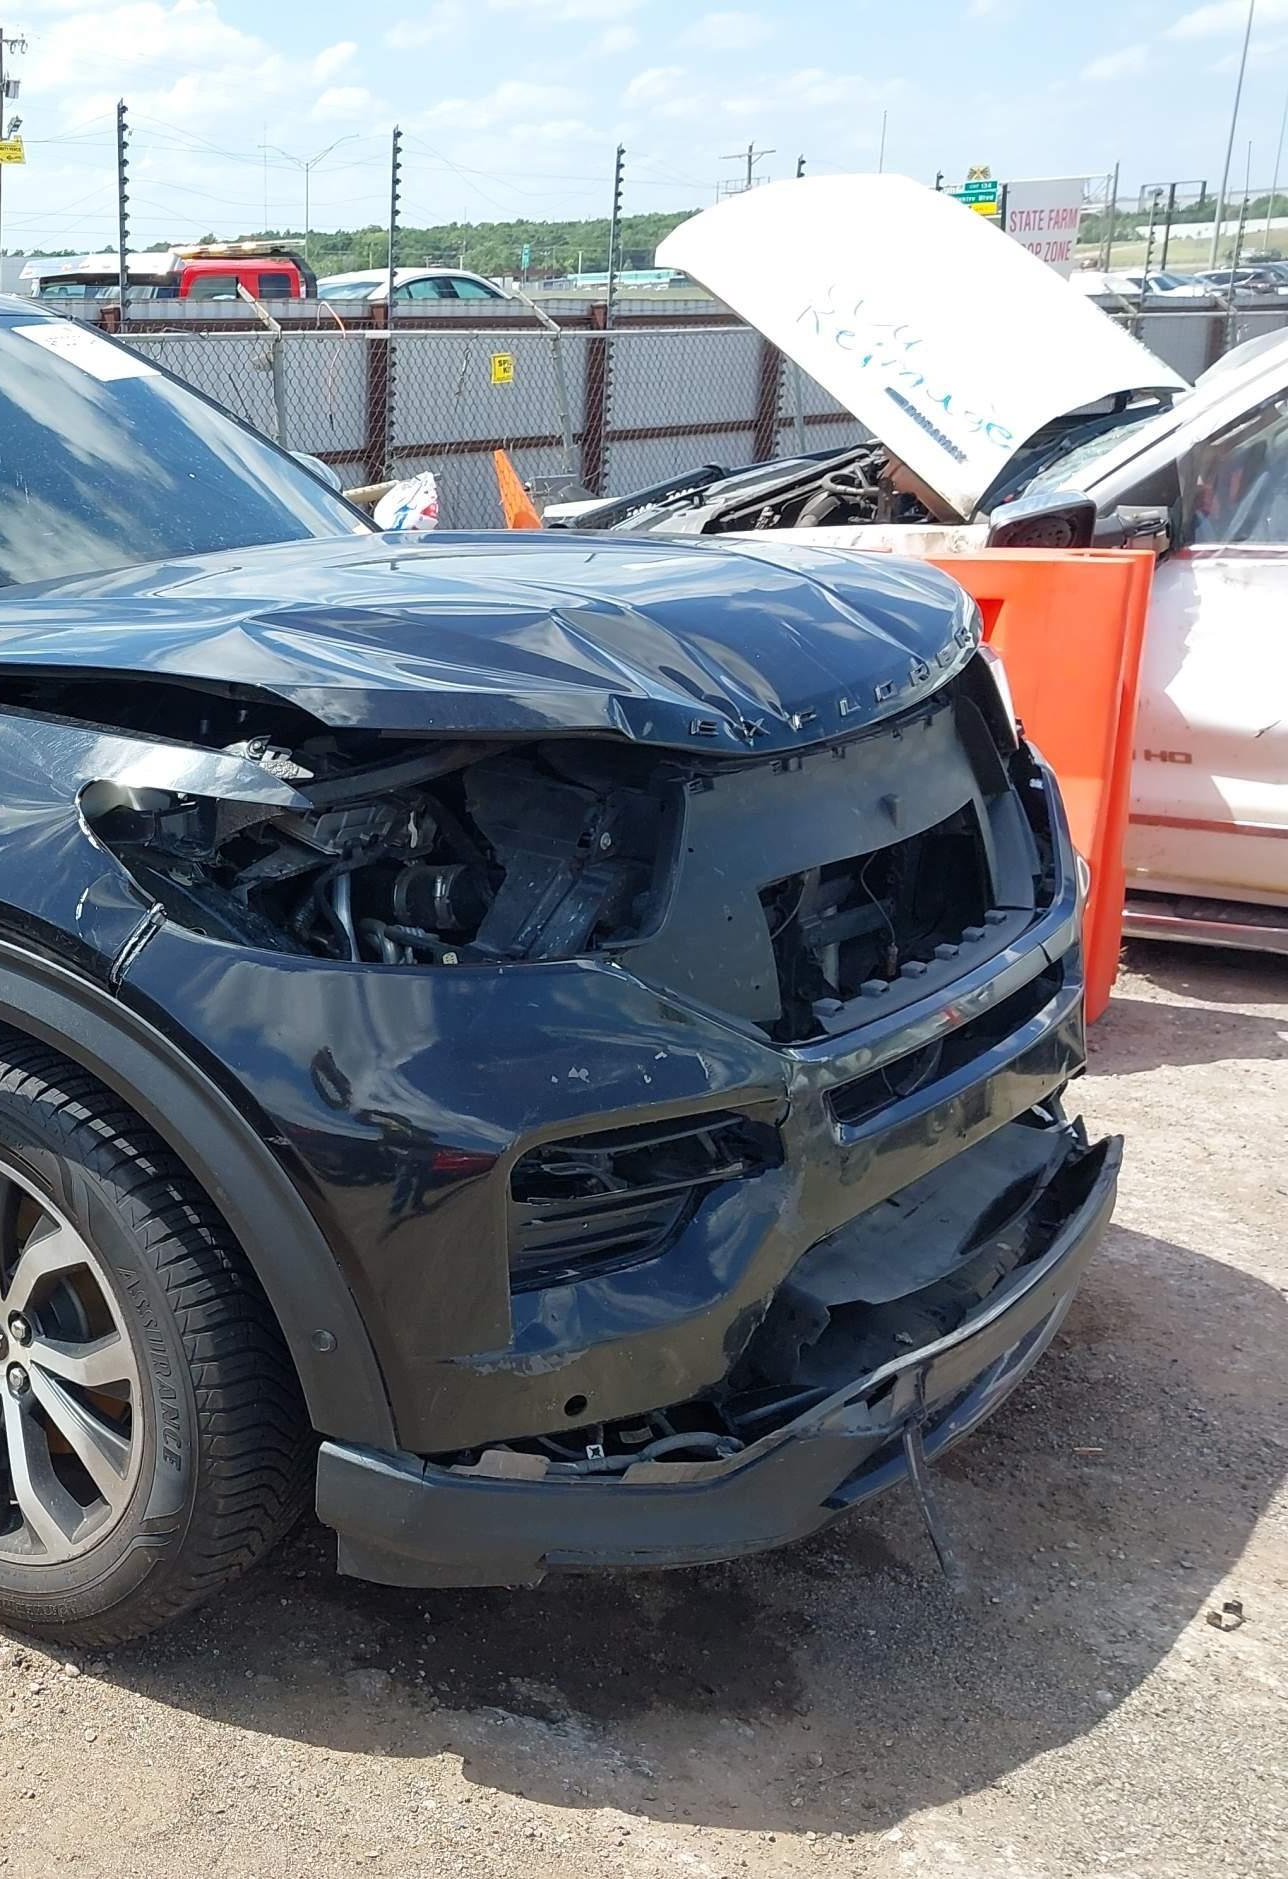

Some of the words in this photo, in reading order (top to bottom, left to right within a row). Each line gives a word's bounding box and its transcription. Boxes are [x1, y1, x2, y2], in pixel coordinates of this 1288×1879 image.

[1010, 210, 1044, 232] STATE
[1048, 208, 1078, 230] FARM
[1044, 240, 1072, 262] ZONE
[690, 626, 972, 746] EXPLORER
[1143, 749, 1193, 765] HD
[115, 1266, 182, 1472] ASSURANCE
